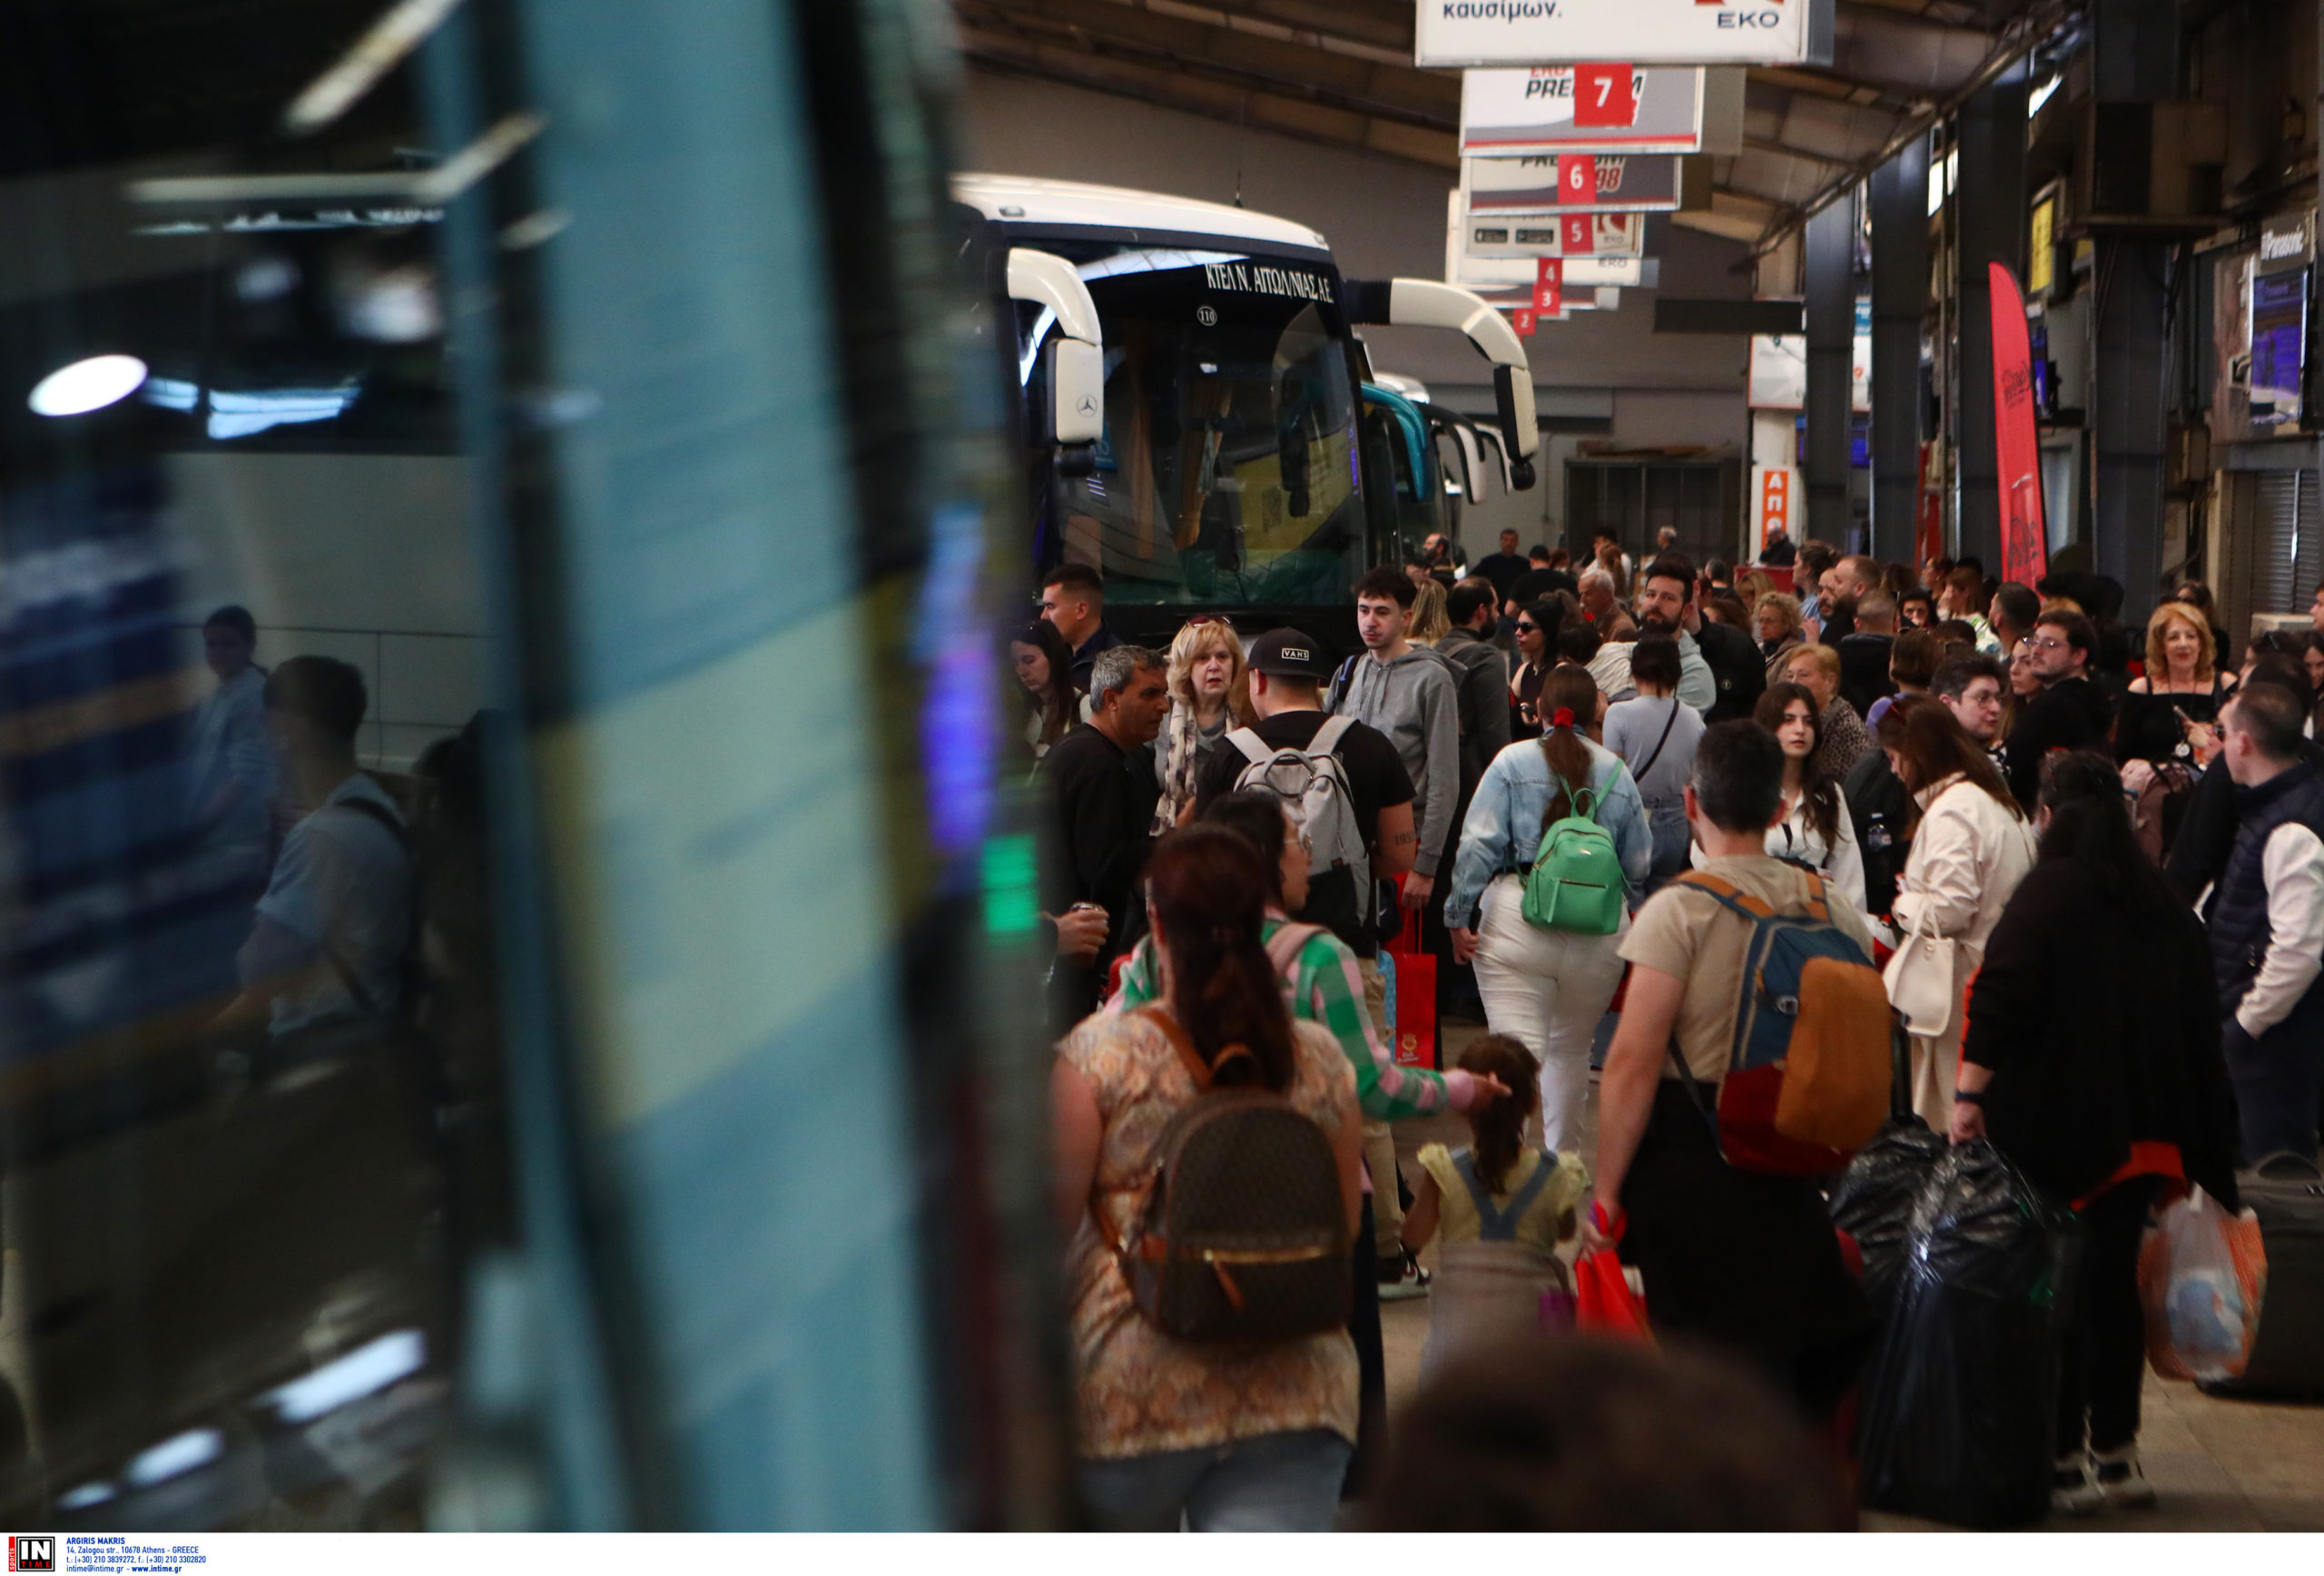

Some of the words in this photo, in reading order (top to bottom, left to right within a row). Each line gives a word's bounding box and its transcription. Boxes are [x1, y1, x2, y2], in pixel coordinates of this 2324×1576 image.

[1443, 0, 1562, 25] καυσίμων.
[1594, 76, 1612, 108] 7
[1570, 163, 1584, 190] 6
[1571, 222, 1582, 242] 5
[1205, 263, 1236, 291] ΚΤΕΛ
[1545, 265, 1555, 282] 4
[1541, 291, 1552, 307] 3
[1200, 310, 1215, 322] 110
[1520, 312, 1530, 328] 2
[1284, 650, 1308, 659] VANS
